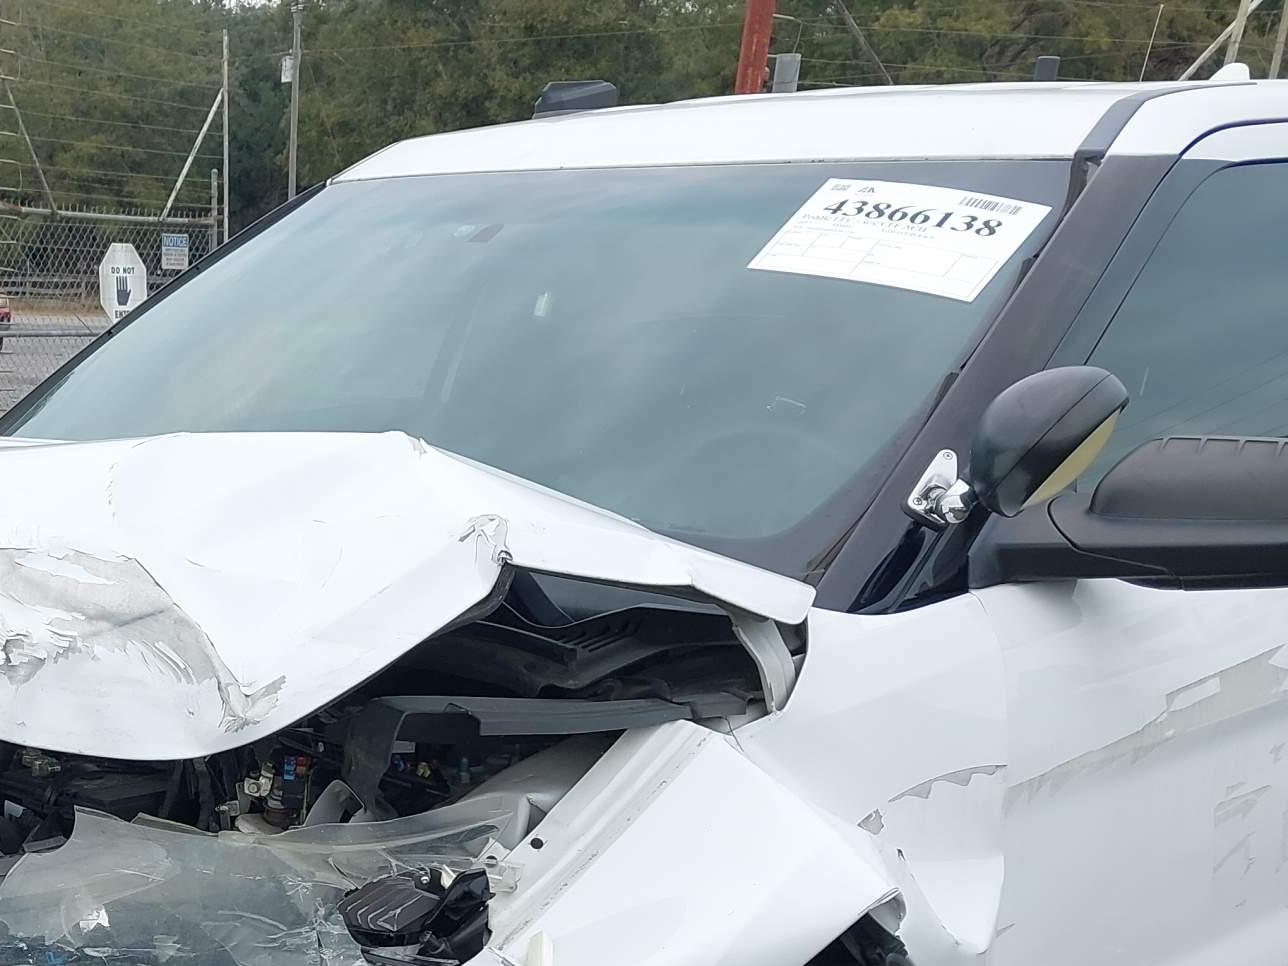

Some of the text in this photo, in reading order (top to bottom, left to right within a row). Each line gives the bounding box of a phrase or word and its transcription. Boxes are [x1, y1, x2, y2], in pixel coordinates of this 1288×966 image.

[823, 199, 1003, 237] 43866138
[164, 236, 187, 247] NOTICE
[111, 266, 135, 275] DO NOT
